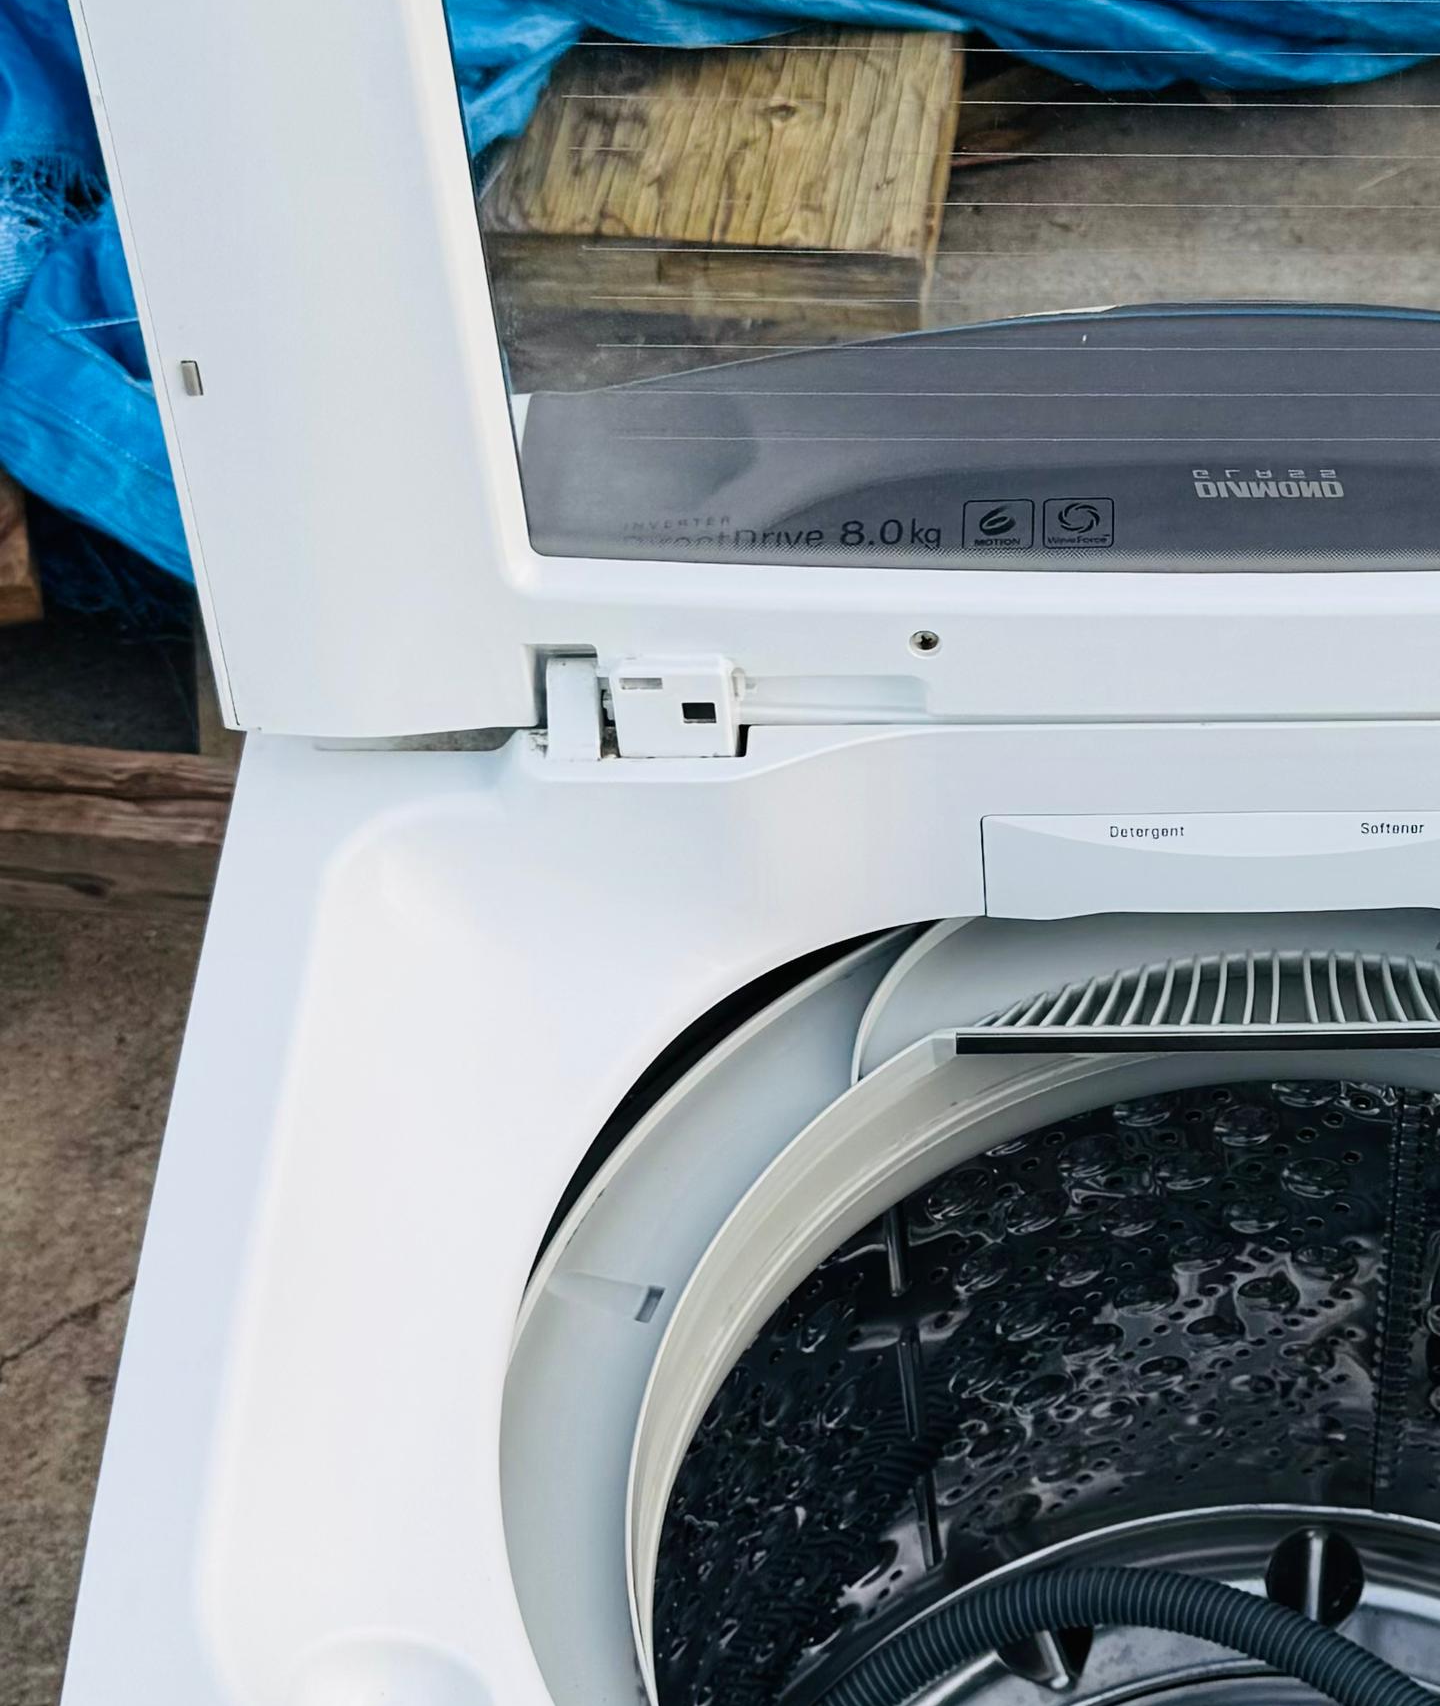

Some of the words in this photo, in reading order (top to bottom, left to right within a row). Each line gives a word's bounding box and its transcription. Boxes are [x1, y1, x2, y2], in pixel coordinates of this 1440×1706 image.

[973, 537, 1021, 547] MOTION
[1109, 825, 1185, 840] Detergent
[1360, 821, 1426, 835] Softener
